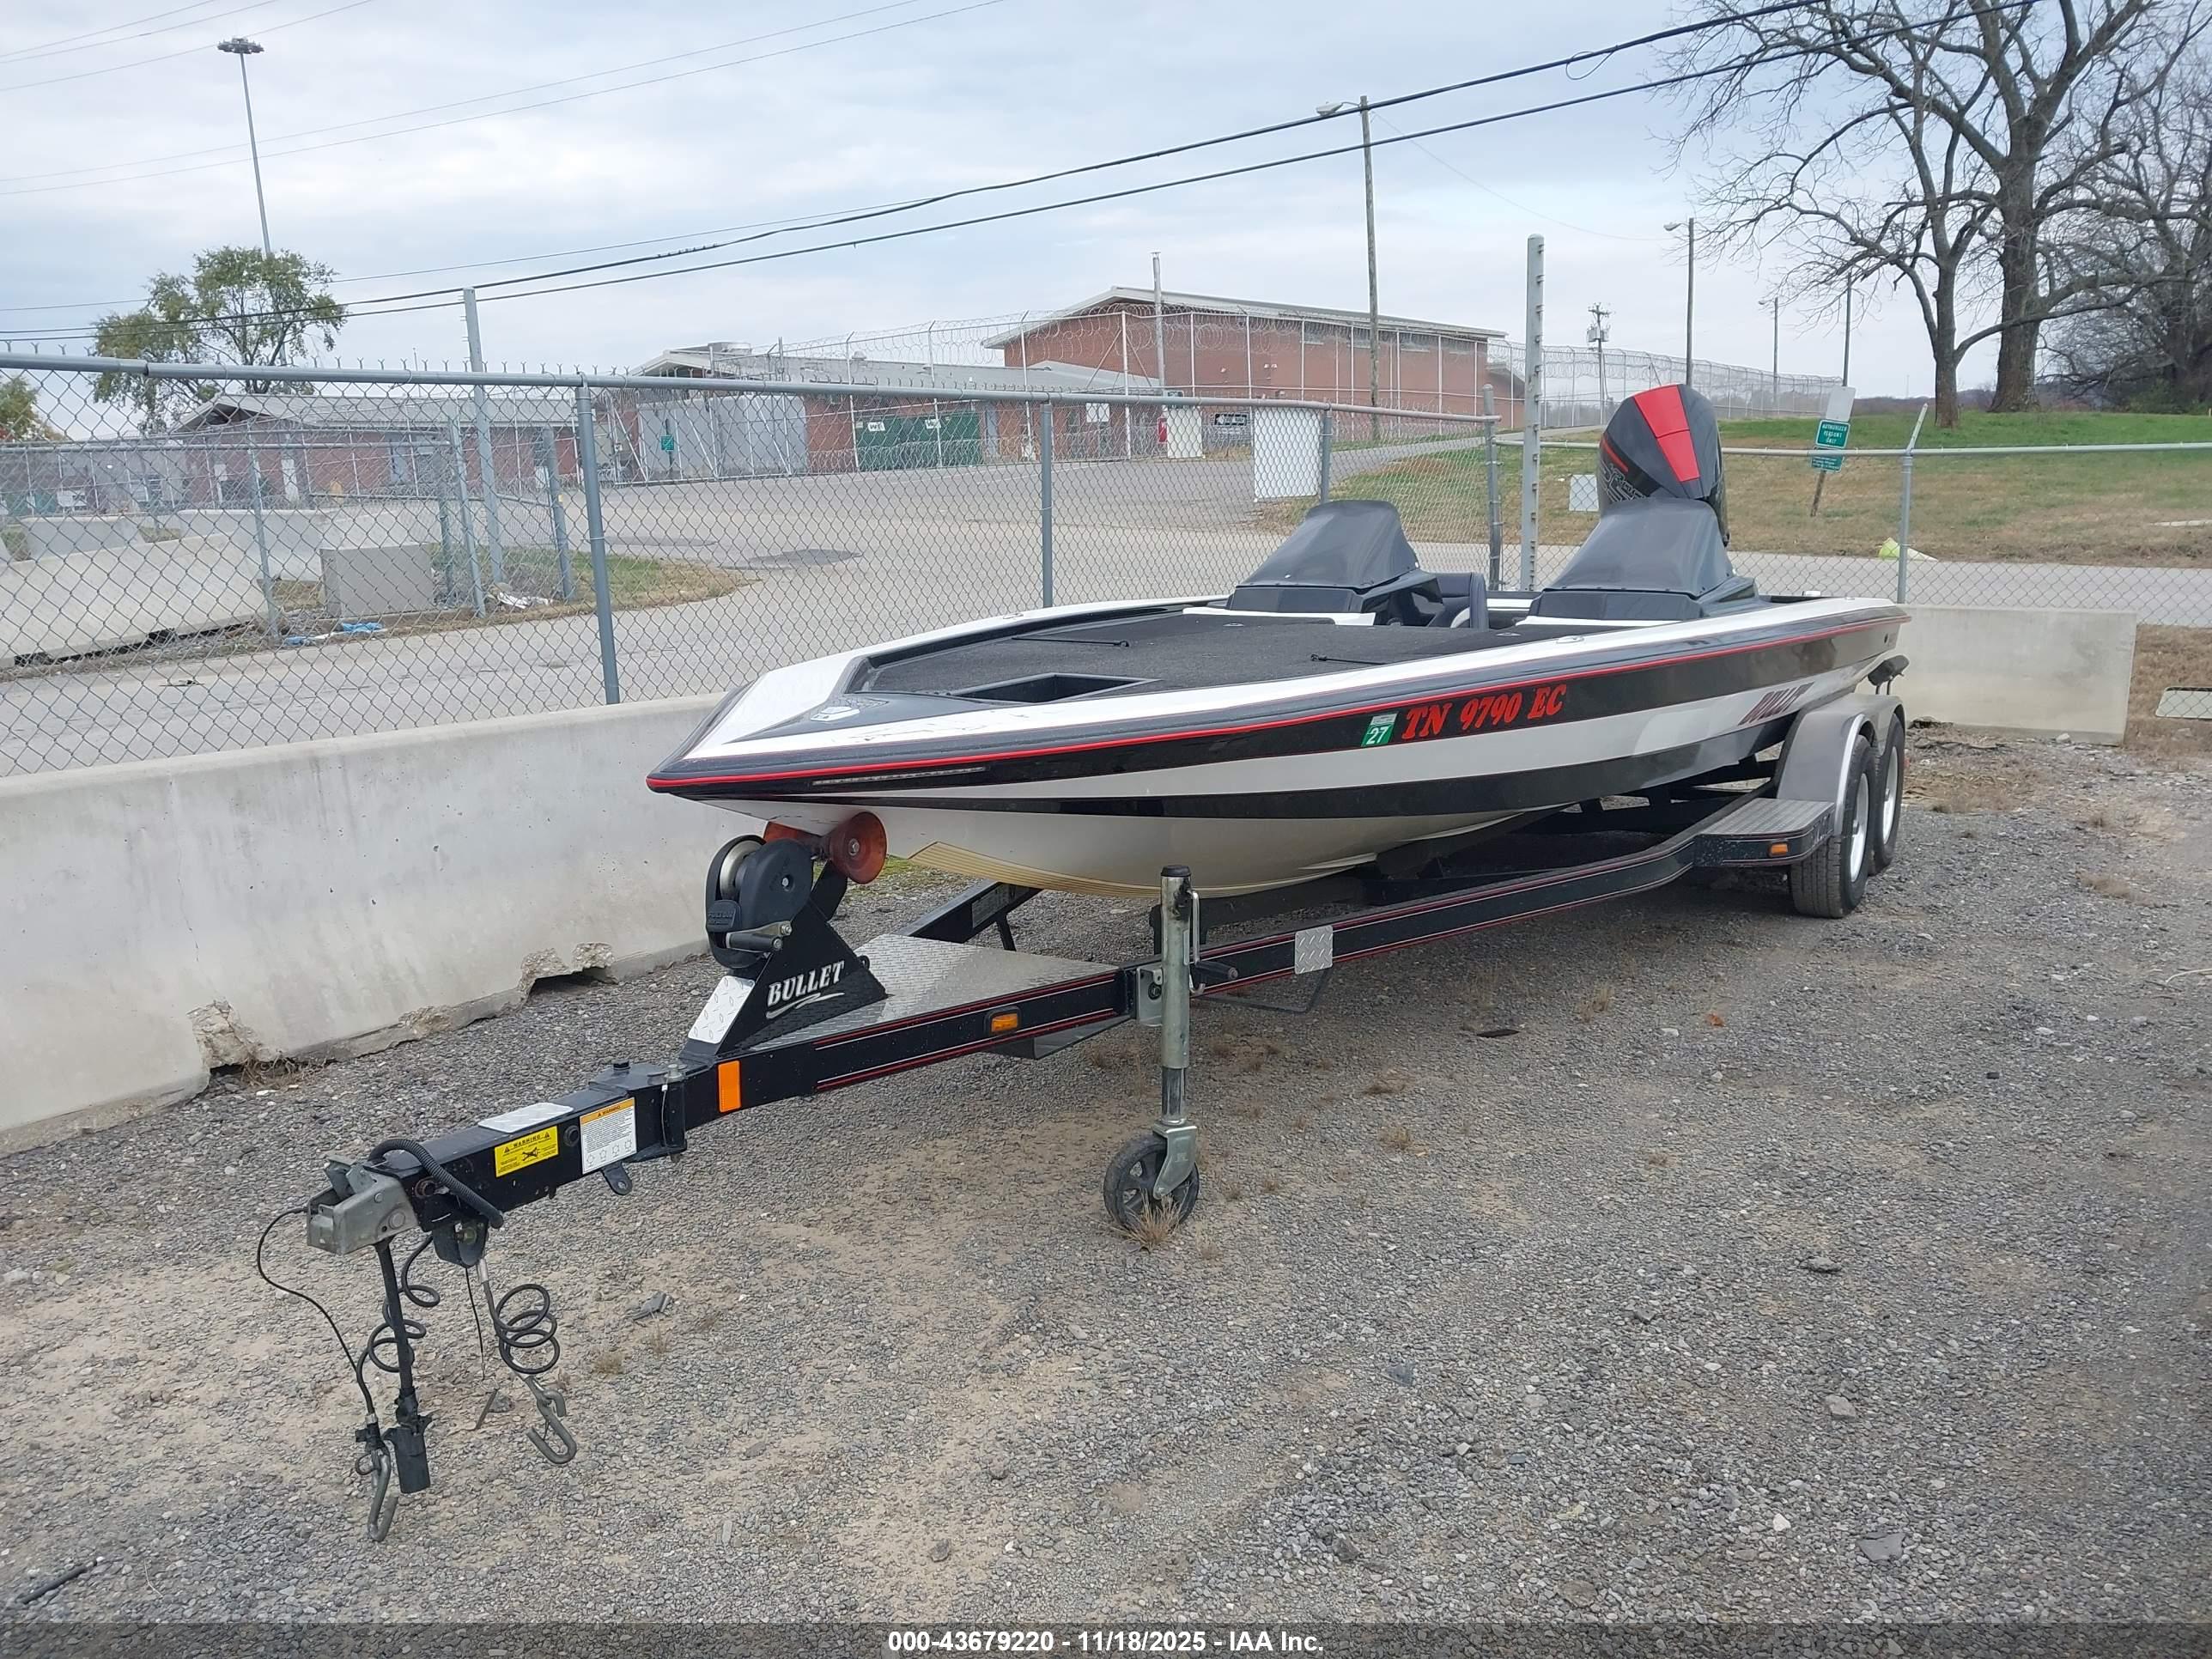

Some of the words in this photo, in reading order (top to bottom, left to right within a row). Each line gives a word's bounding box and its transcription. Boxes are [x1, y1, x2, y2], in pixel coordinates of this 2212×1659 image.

[1401, 702, 1453, 740] TN
[1460, 692, 1522, 730] 9790
[1527, 684, 1567, 720] EC
[1366, 726, 1389, 744] 27
[766, 960, 845, 1007] BULLET
[513, 1134, 541, 1148] WARNING
